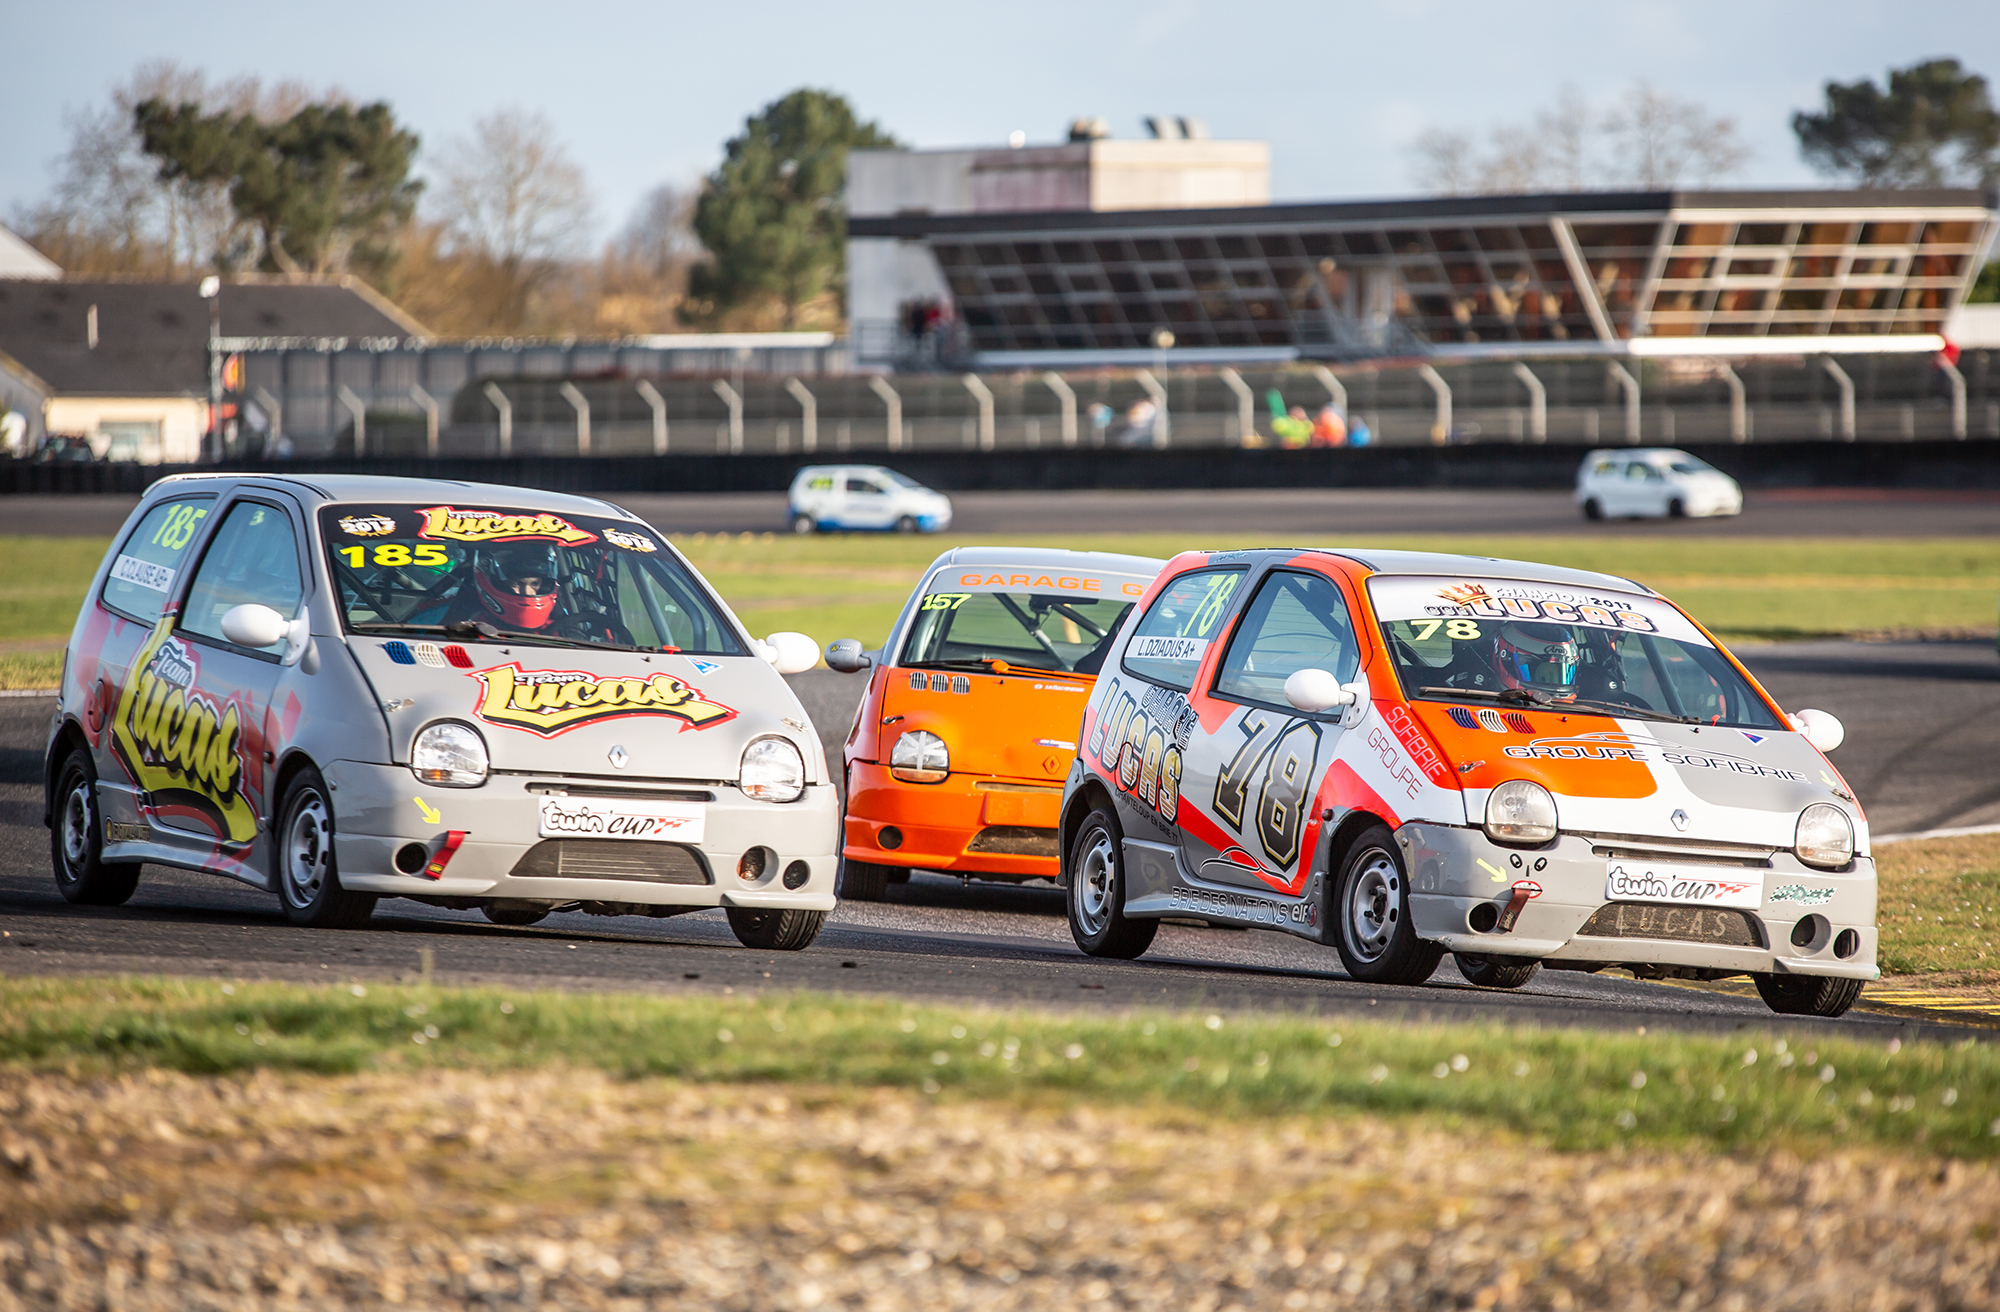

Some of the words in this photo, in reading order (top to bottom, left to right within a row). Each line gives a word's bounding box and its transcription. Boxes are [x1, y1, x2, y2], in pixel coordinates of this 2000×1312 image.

[152, 504, 208, 550] 185
[425, 507, 591, 542] Lucas
[339, 544, 449, 568] 185
[921, 593, 973, 610] 157
[959, 573, 1102, 593] GARAGE
[1182, 573, 1239, 637] 78
[1469, 597, 1658, 633] LUCAS
[1137, 639, 1185, 657] L.DZIADUS
[1183, 640, 1196, 658] A+
[1410, 619, 1482, 641] 78
[154, 641, 192, 686] Team
[481, 666, 728, 733] Lucas
[113, 617, 257, 842] Lucas
[1385, 706, 1447, 781] SOFIBRIE
[1088, 676, 1184, 826] LUCAS
[1367, 727, 1423, 800] GROUPE
[1503, 746, 1650, 762] GROUPE
[1662, 752, 1812, 784] SOFIBRIE
[1212, 707, 1324, 873] 78
[1169, 886, 1200, 911] BRIE
[1200, 890, 1228, 917] DES
[1227, 895, 1289, 926] NATIONS
[1615, 905, 1729, 936] LUCAS
